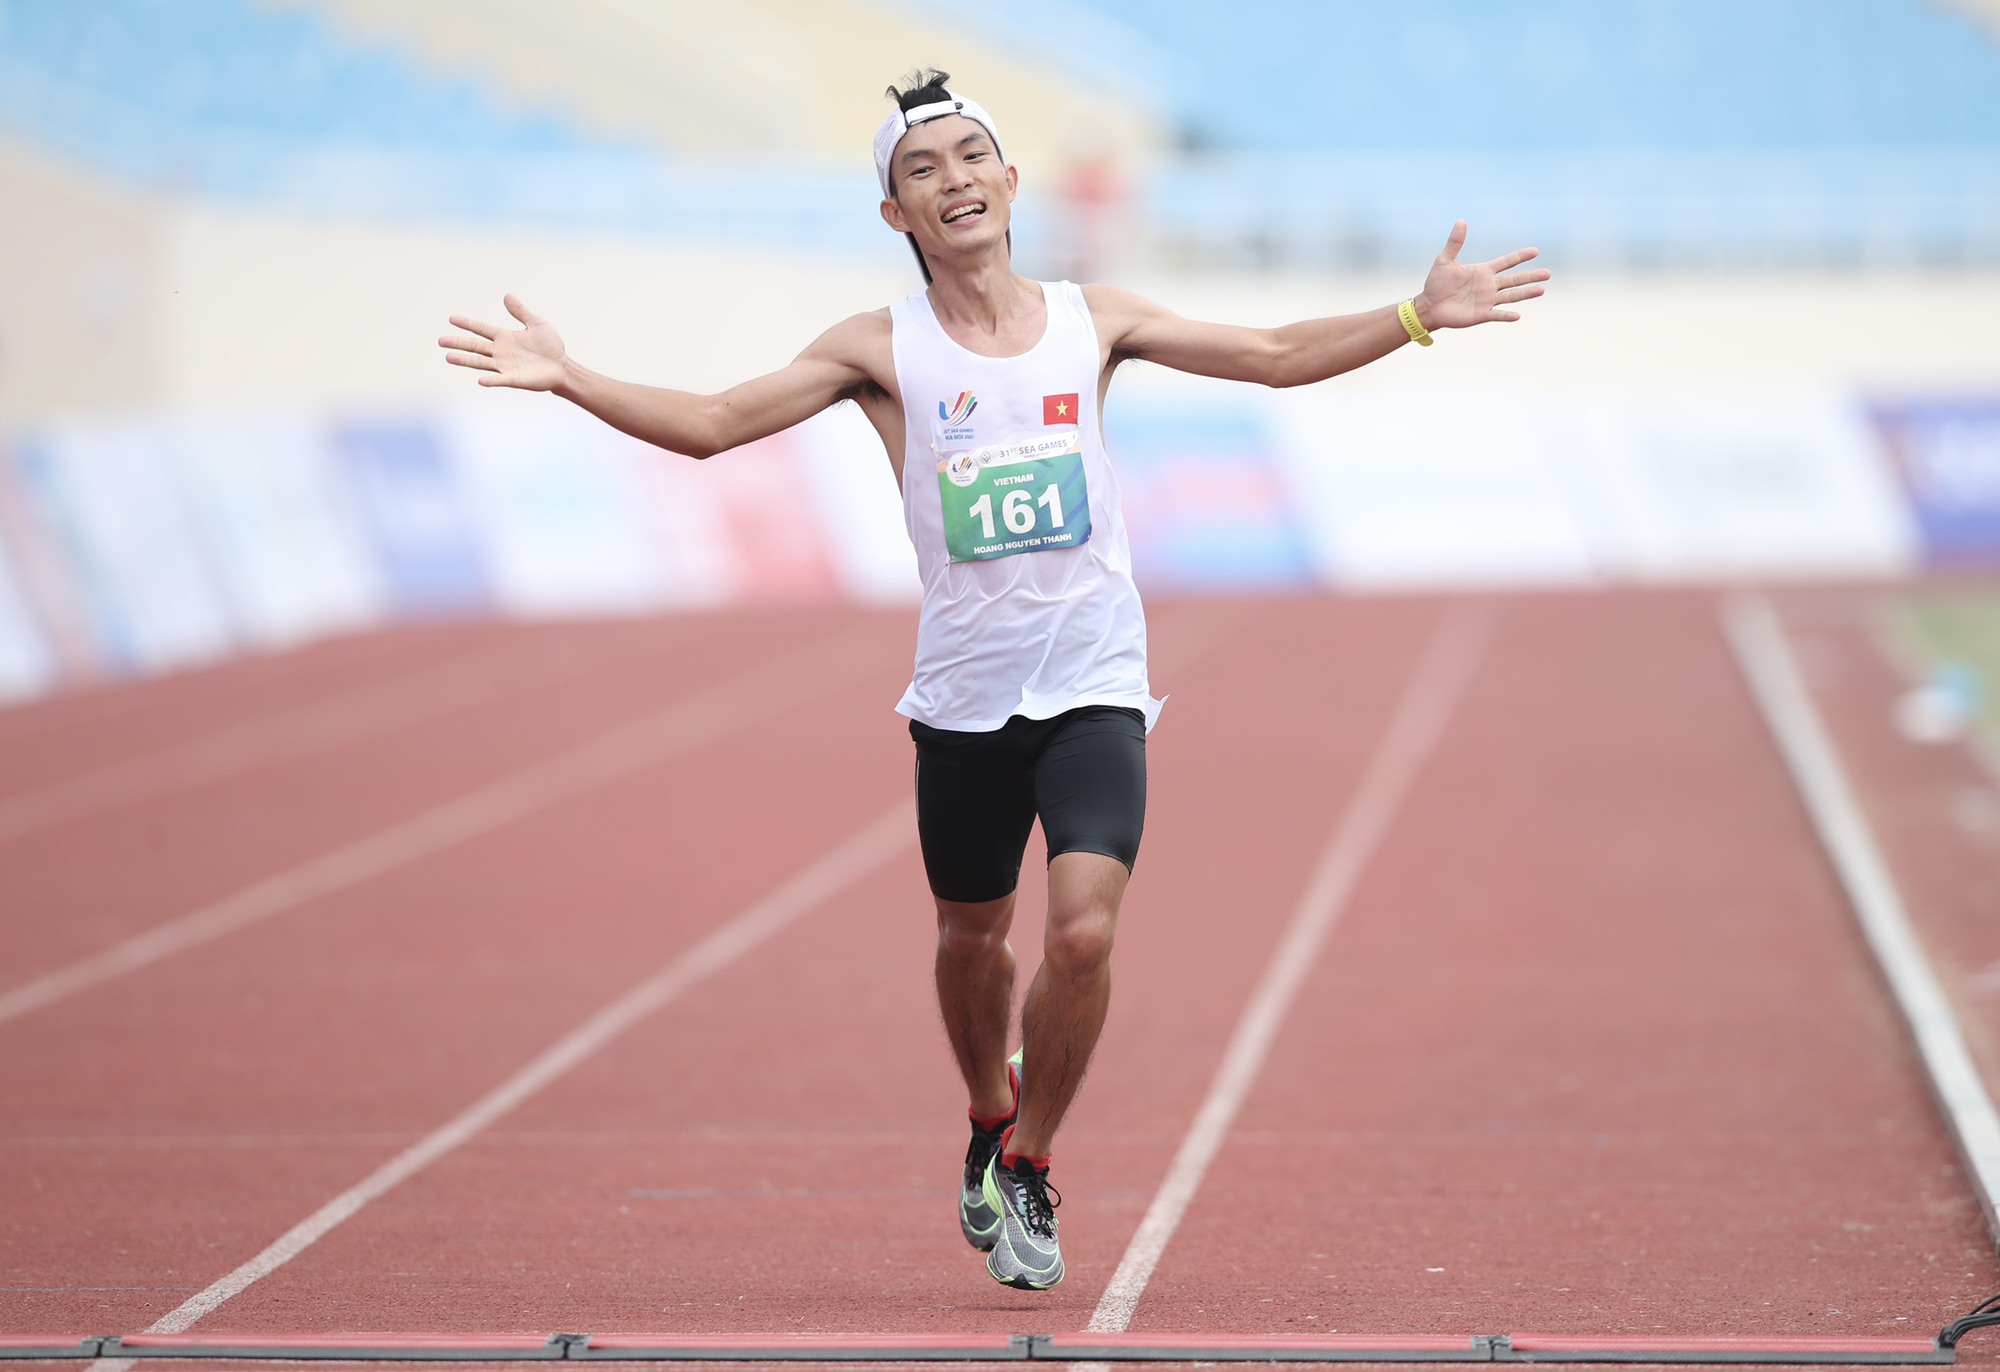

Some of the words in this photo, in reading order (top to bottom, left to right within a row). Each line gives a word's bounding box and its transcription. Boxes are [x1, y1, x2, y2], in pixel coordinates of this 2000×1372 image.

[1019, 445, 1036, 455] SEA
[1038, 440, 1068, 451] GAMES
[993, 473, 1034, 486] VIETNAM
[969, 483, 1065, 539] 161
[973, 543, 1004, 554] HOANG
[1005, 538, 1041, 550] NGUYEN
[1042, 533, 1072, 545] THANH
